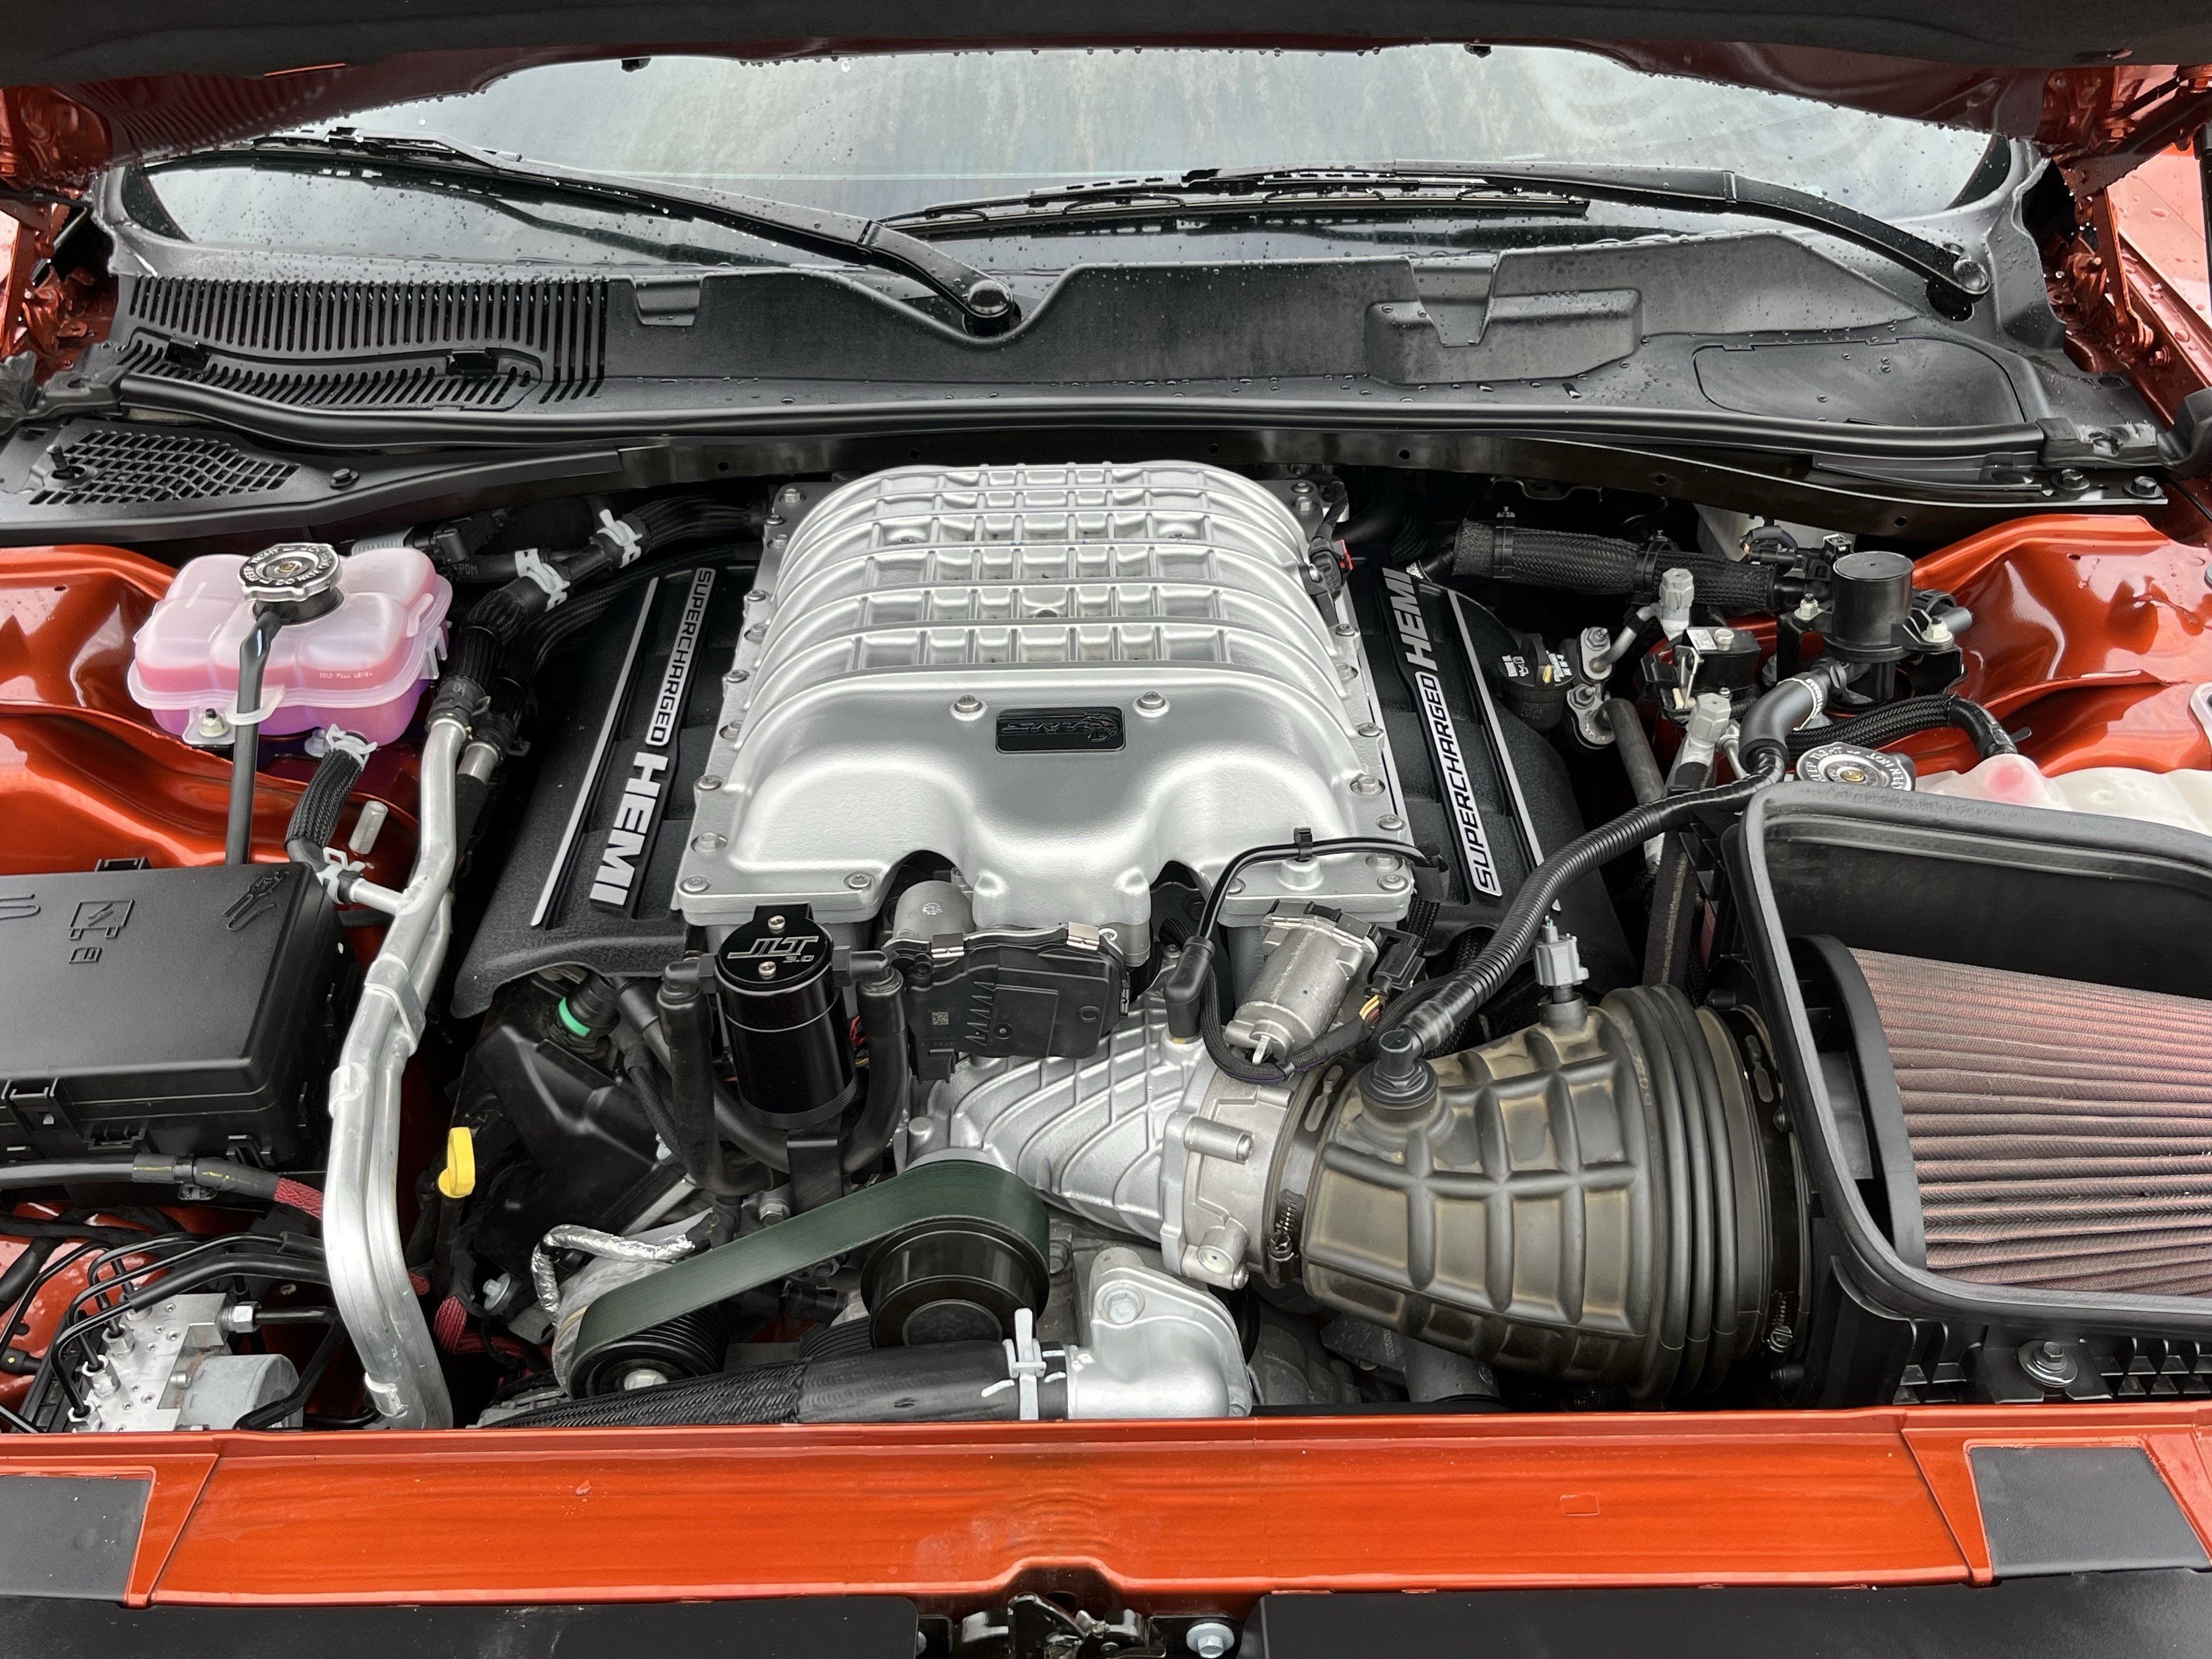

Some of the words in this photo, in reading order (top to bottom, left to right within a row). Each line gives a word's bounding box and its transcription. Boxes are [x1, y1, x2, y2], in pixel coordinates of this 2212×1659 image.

[275, 578, 295, 586] DO
[1382, 567, 1438, 672] HEMI
[648, 569, 713, 743] SUPERCHARGED
[590, 752, 668, 906] HEMI
[1420, 674, 1497, 892] SUPERCHARGED
[727, 935, 819, 960] JLT
[782, 955, 815, 963] 3.0
